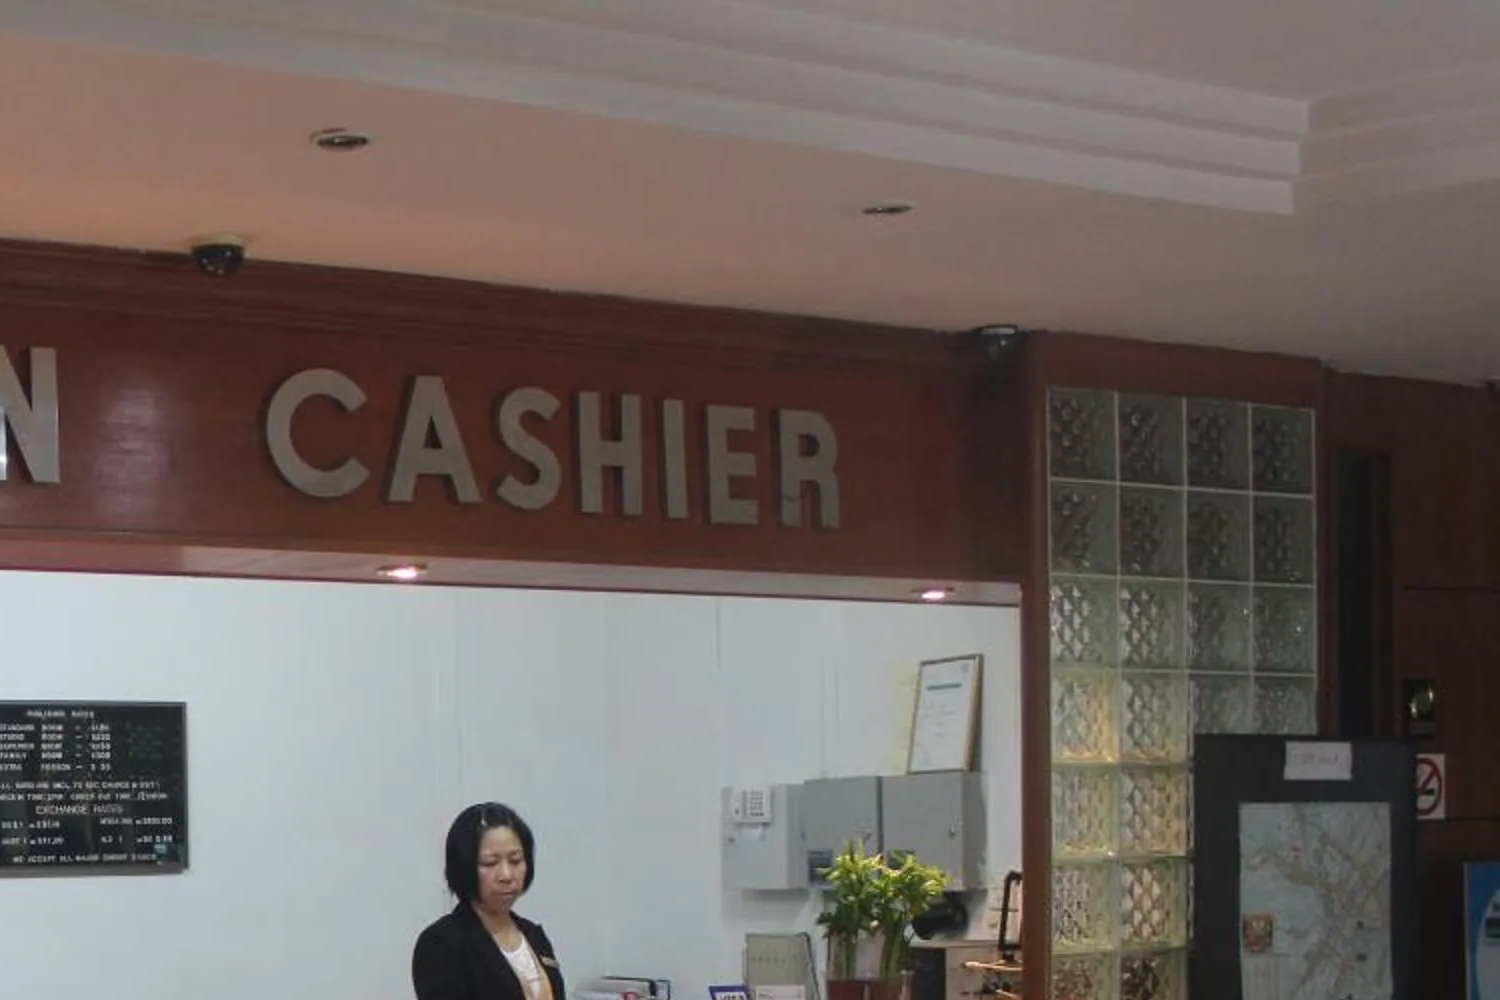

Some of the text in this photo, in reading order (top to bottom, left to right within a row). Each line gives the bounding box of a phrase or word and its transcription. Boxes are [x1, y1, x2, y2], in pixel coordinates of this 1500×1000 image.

[265, 368, 840, 529] CASHIER
[36, 805, 124, 815] EXCHANGE RATES
